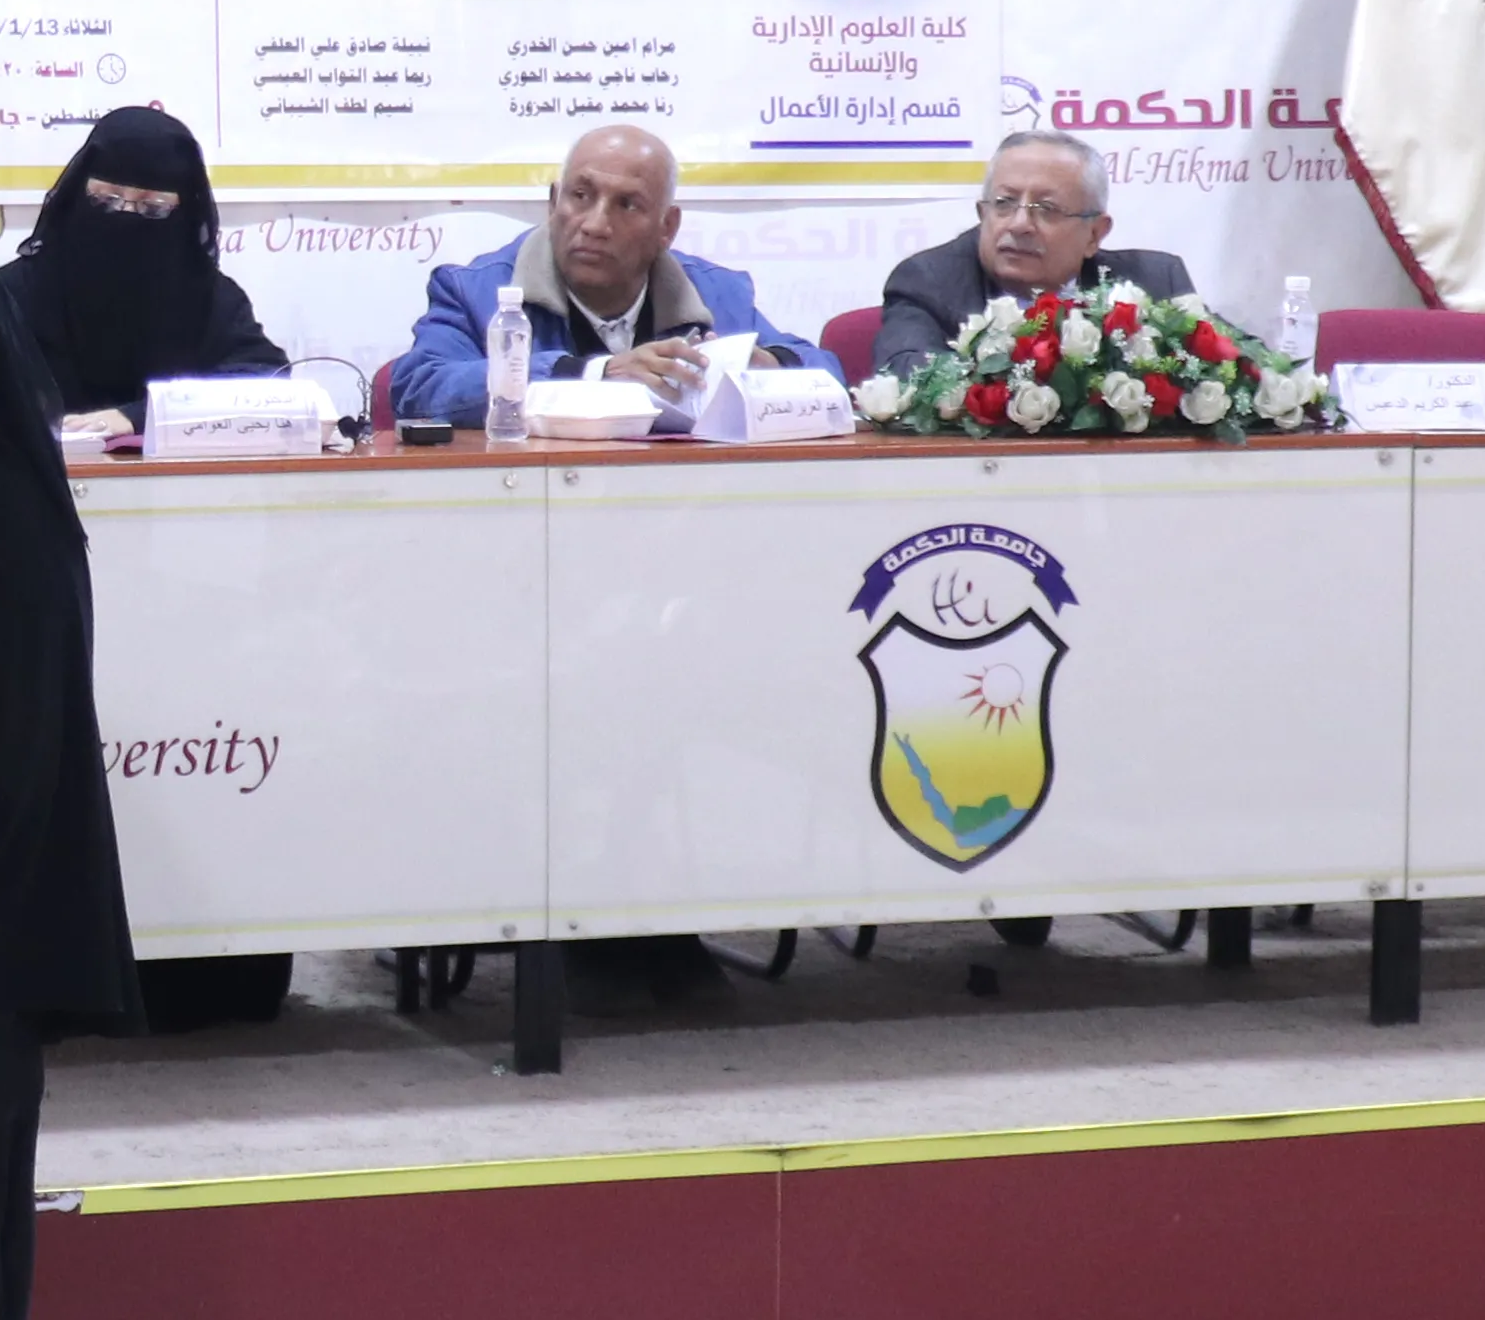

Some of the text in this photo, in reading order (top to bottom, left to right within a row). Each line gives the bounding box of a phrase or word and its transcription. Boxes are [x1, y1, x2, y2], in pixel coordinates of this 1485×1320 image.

[63, 18, 112, 37] الثلاثاء
[752, 16, 967, 45] كلية العلوم الإدارية
[553, 69, 592, 84] محمد
[809, 51, 918, 81] والإنسانية
[610, 99, 649, 114] محمد
[760, 95, 961, 125] قسم إدارة الأعمال
[259, 210, 444, 263] University
[884, 527, 1047, 573] جامعة الحكمة
